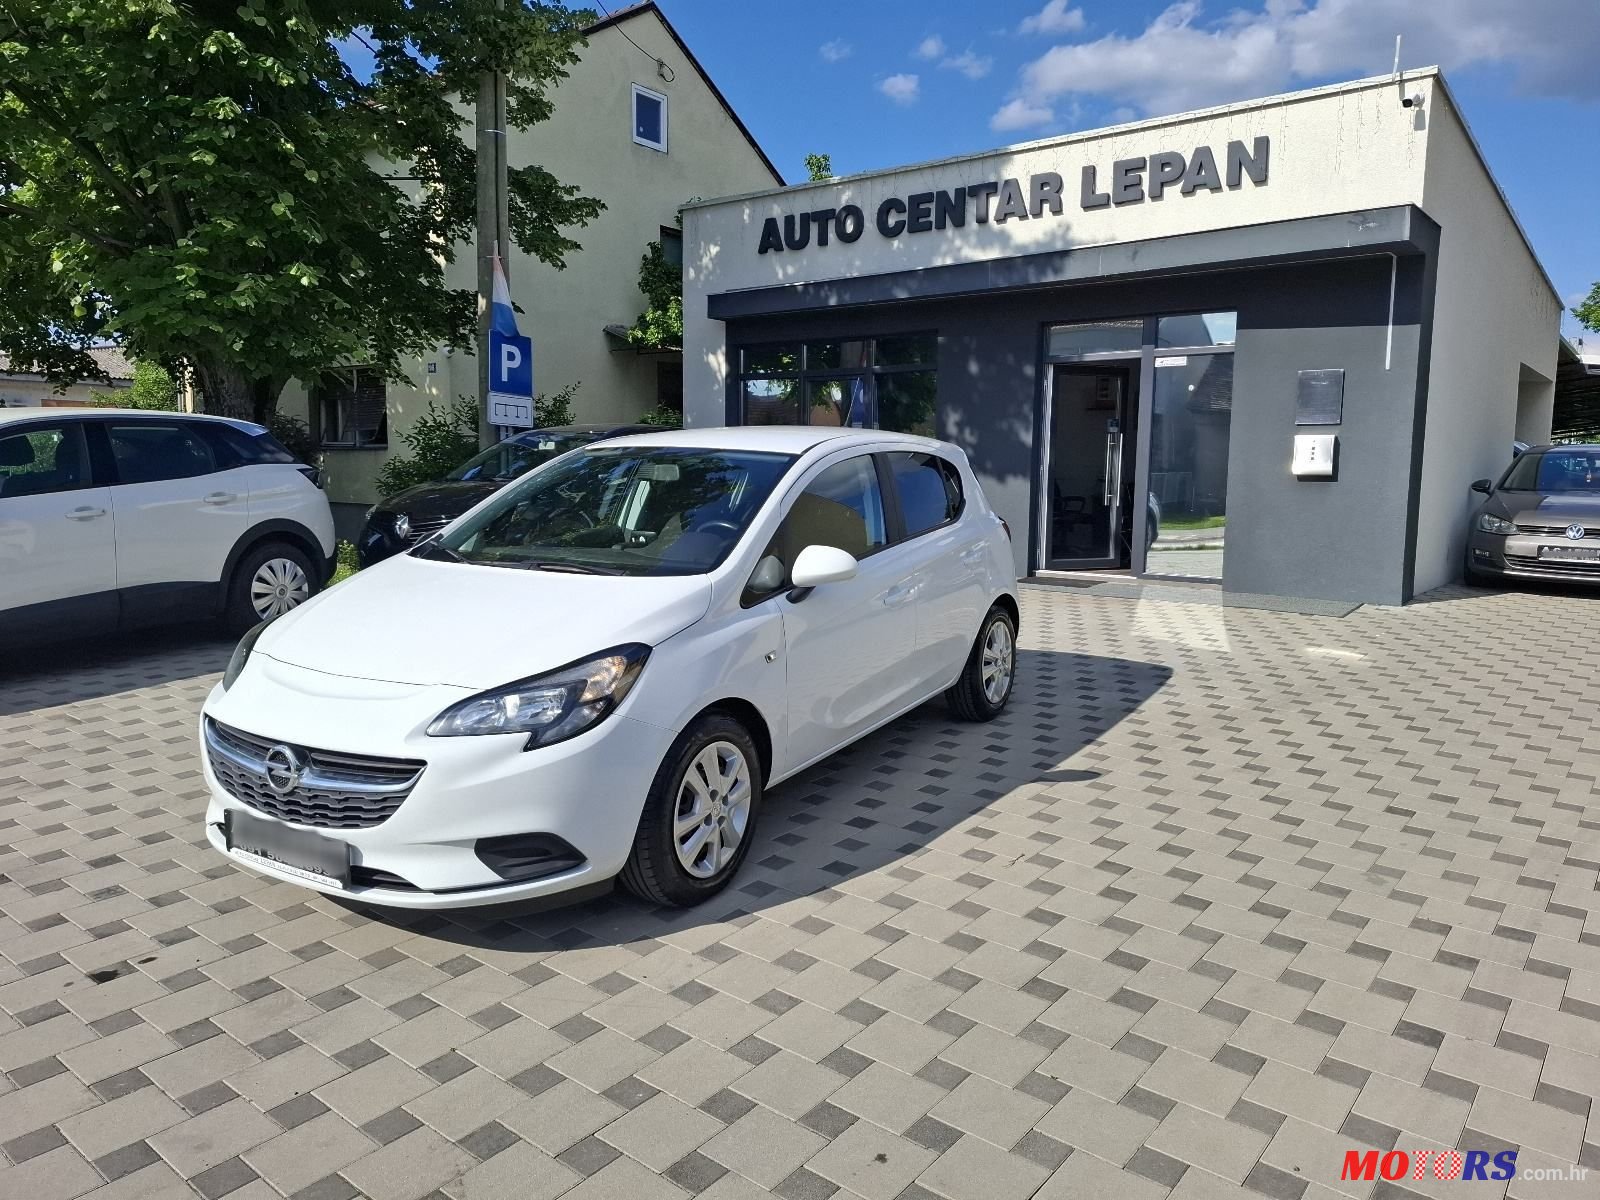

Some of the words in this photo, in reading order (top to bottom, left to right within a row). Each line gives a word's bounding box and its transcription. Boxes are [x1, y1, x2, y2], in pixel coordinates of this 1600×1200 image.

[757, 204, 865, 255] AUTO
[876, 172, 1064, 238] CENTAR
[1080, 136, 1269, 210] LEPAN
[501, 343, 522, 382] P
